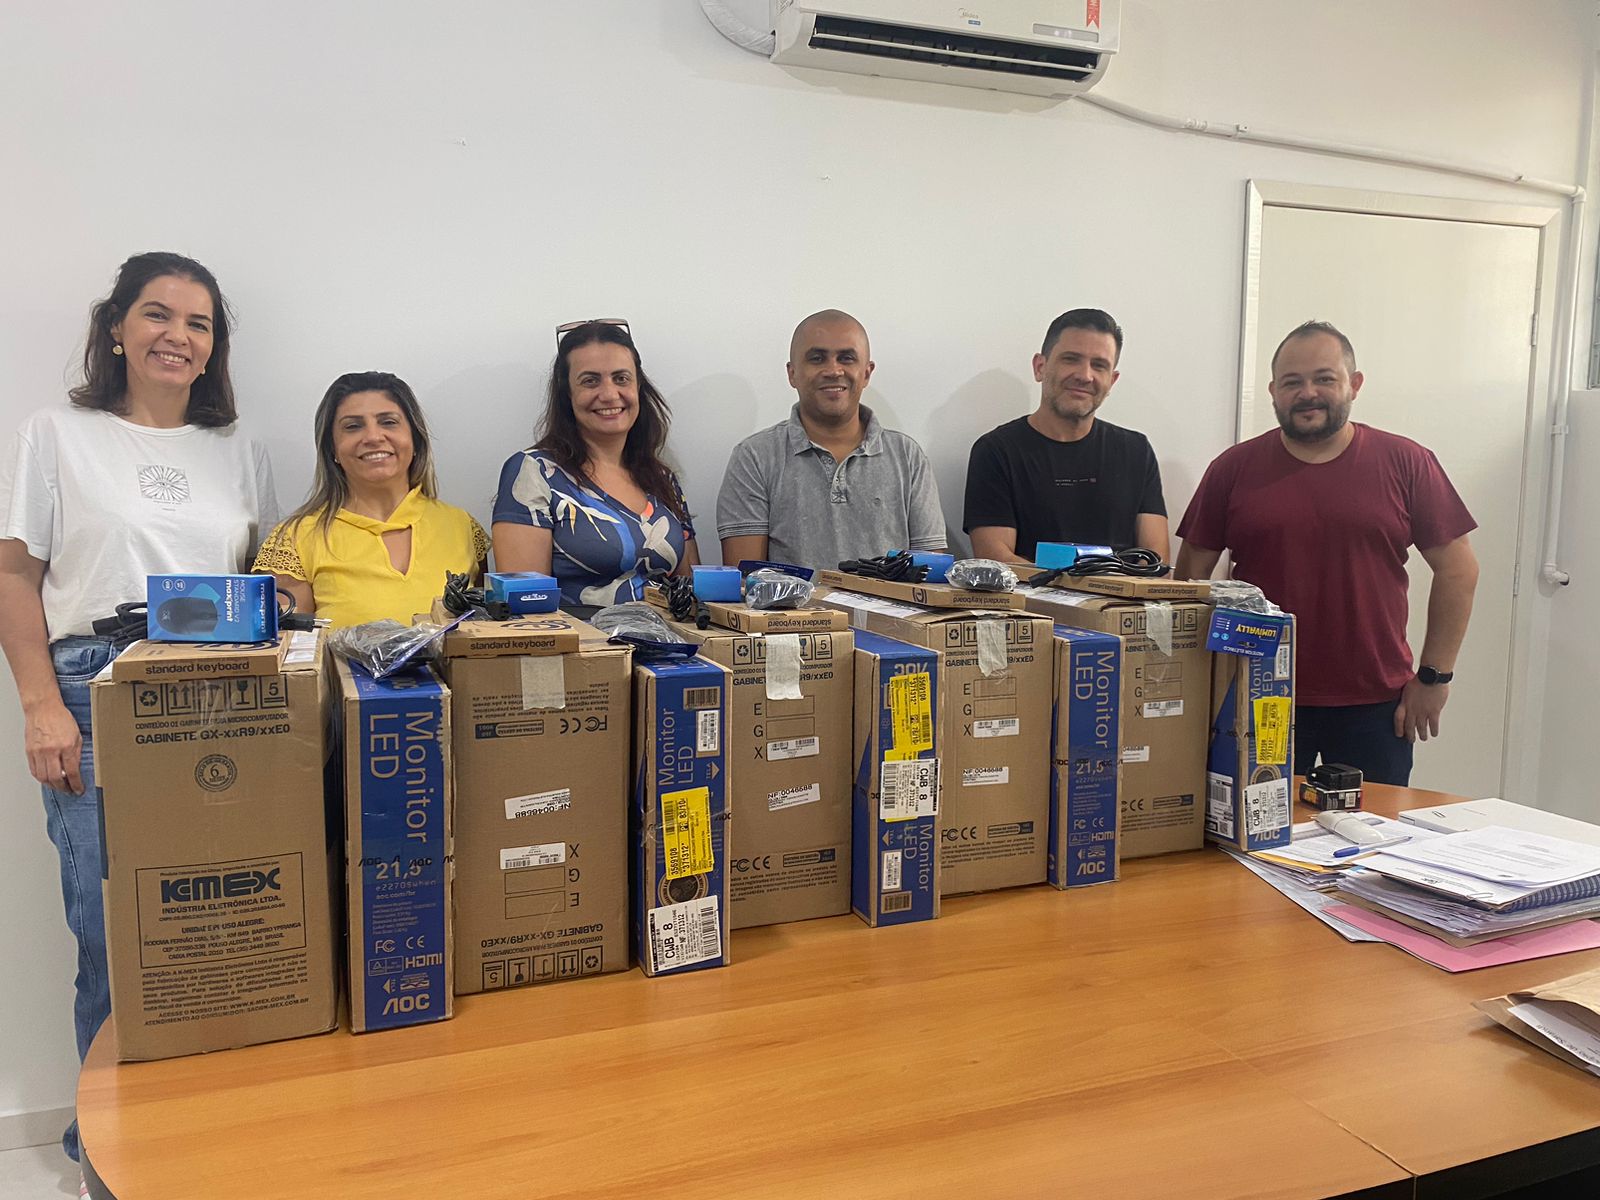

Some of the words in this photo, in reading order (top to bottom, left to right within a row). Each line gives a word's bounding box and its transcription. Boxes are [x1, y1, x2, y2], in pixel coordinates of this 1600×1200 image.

[767, 617, 801, 627] keyboard
[802, 618, 832, 626] standard
[1187, 614, 1193, 623] 5
[1022, 625, 1029, 635] 5
[470, 639, 511, 651] standard
[512, 638, 556, 650] keyboard
[820, 639, 828, 651] 5
[145, 662, 195, 675] standard
[196, 660, 250, 674] keyboard
[1135, 668, 1142, 679] E
[1075, 652, 1094, 701] LED
[268, 682, 279, 696] 5
[963, 683, 972, 696] E
[1134, 687, 1143, 698] G
[1095, 651, 1115, 749] Monitor
[753, 703, 762, 716] E
[963, 704, 972, 716] G
[1134, 705, 1142, 716] X
[135, 730, 197, 744] GABINETE
[200, 724, 291, 741] GX-xxR9/xxE0
[753, 725, 764, 738] G
[963, 725, 972, 737] X
[370, 713, 400, 779] LED
[658, 708, 676, 786] Monitor
[753, 747, 764, 760] X
[210, 763, 219, 777] 6
[677, 745, 694, 784] LED
[405, 711, 434, 843] Monitor
[919, 767, 929, 789] CWB
[918, 793, 929, 801] 8
[1091, 830, 1115, 843] HDMI
[569, 843, 580, 858] X
[918, 823, 934, 892] Monitor
[1076, 860, 1106, 876] AOC
[568, 868, 580, 883] G
[162, 902, 205, 916] INDÚSTRIA
[208, 896, 258, 910] ELETRÔNICA
[569, 892, 580, 907] E
[557, 923, 603, 938] GABINETE
[662, 922, 674, 933] 8
[663, 935, 676, 960] CWB
[405, 953, 443, 970] HDMI
[489, 971, 498, 982] 5
[382, 993, 430, 1016] AOC
